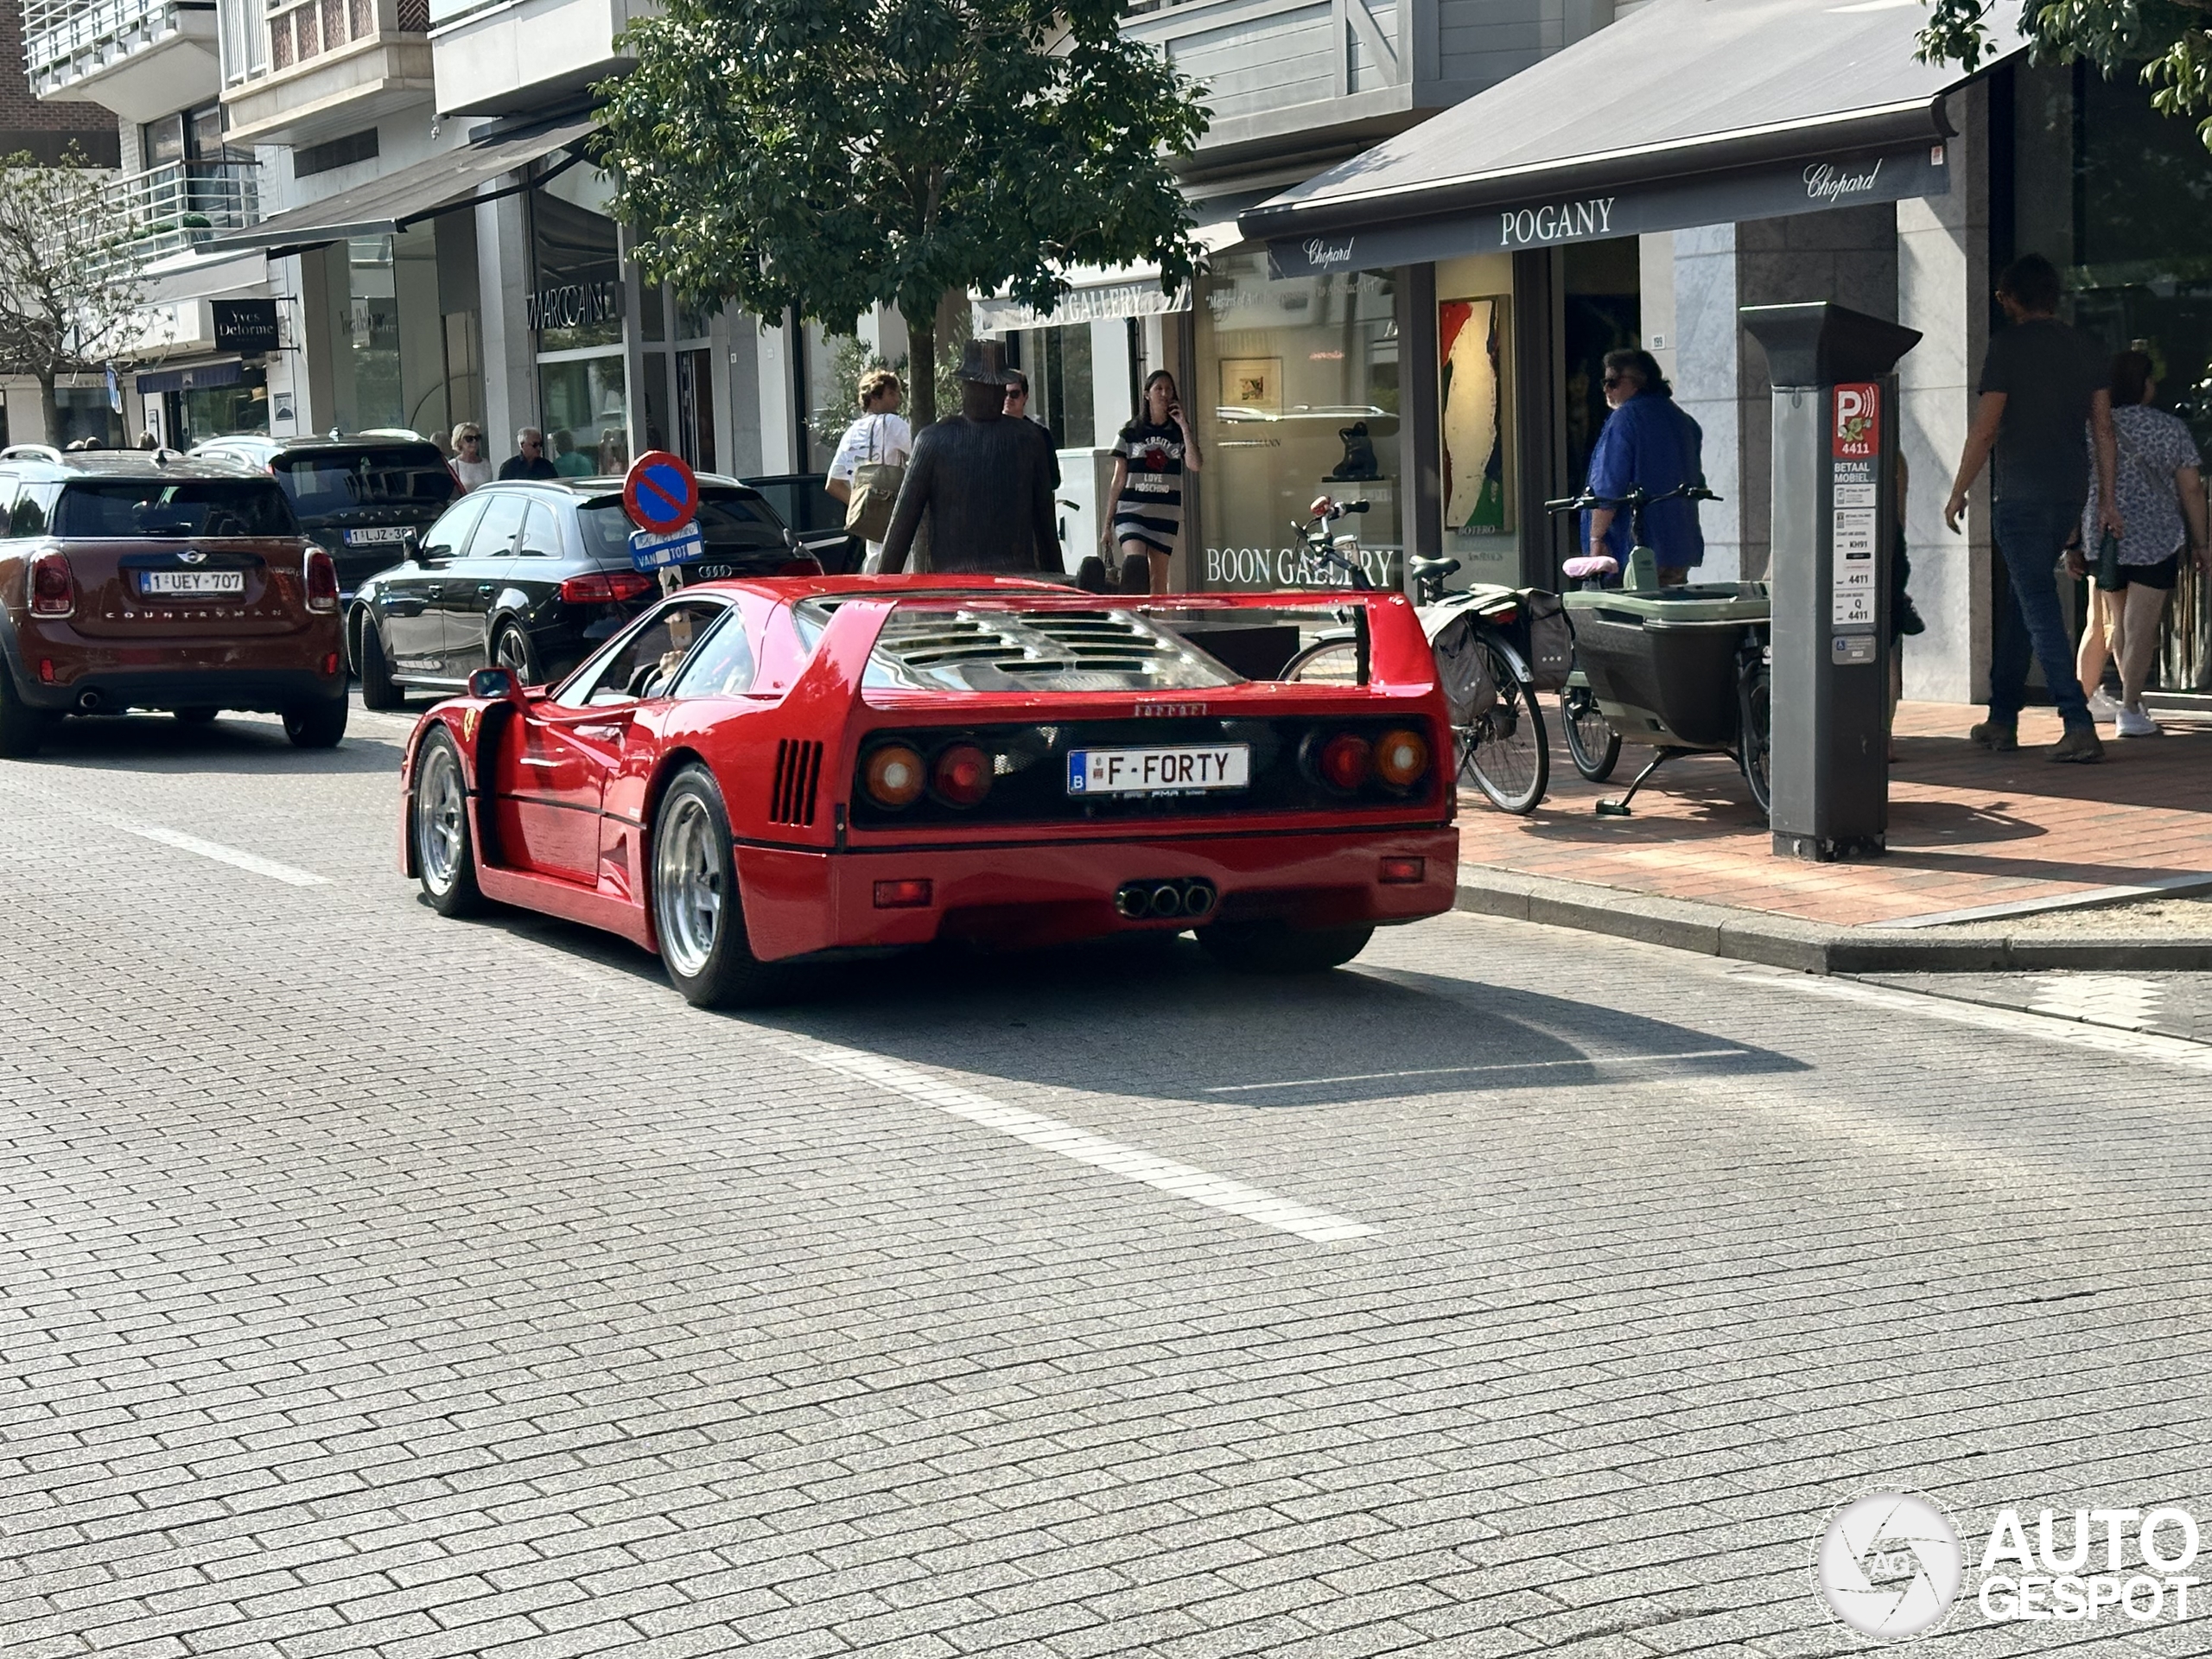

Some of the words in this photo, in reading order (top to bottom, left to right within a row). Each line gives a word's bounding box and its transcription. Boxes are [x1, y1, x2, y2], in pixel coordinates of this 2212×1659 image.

[1803, 157, 1883, 202] Chopard
[1500, 197, 1615, 246] POGANY
[1303, 237, 1356, 270] Chopard
[1068, 285, 1142, 322] GALLERY
[231, 310, 260, 323] Yves
[219, 323, 274, 336] Delorme
[1842, 442, 1870, 454] 4411
[1834, 462, 1870, 473] BETAAL
[1143, 473, 1163, 482] LOVE
[1458, 525, 1495, 535] BOTERO
[1849, 540, 1868, 549] KH91
[638, 554, 657, 568] VAN
[670, 545, 687, 560] TOT
[1206, 548, 1271, 583] BOON
[1848, 575, 1868, 584] 4411
[1854, 599, 1862, 609] Q
[105, 608, 282, 619] COUNTRYMAN
[1848, 610, 1867, 620] 4411
[1073, 775, 1084, 789] B
